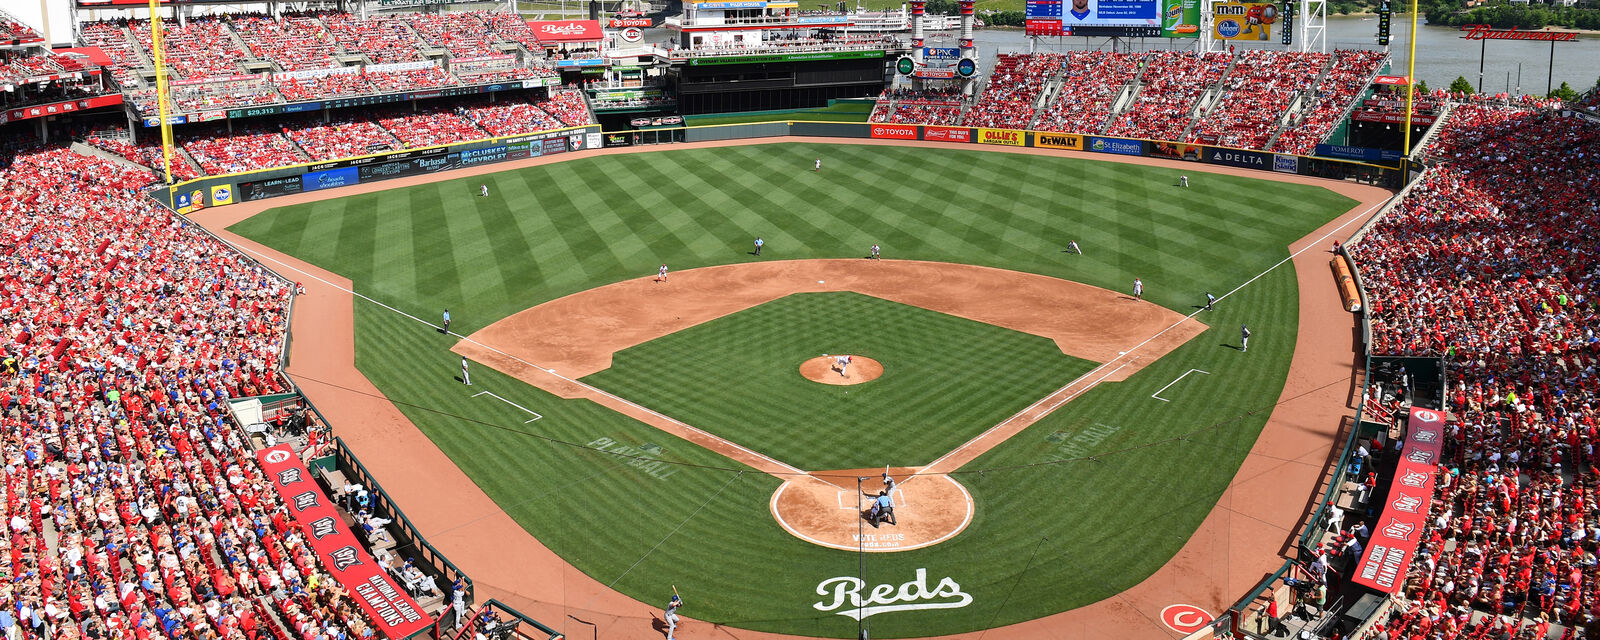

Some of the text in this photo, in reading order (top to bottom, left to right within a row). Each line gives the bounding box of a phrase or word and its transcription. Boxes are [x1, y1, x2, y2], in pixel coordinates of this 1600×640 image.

[542, 23, 586, 34] Reds
[1220, 22, 1238, 35] Kroger
[1462, 24, 1578, 41] Budweiser
[248, 108, 274, 116] $29,313
[1112, 142, 1140, 150] Elizabeth
[1331, 146, 1365, 154] POMEROY
[420, 156, 447, 168] Barbasol
[462, 153, 507, 165] CHEVROLET
[1225, 154, 1263, 165] DELTA
[1276, 155, 1297, 164] Kings
[1275, 163, 1297, 172] Island
[1388, 522, 1410, 539] 1919
[334, 548, 356, 566] 1972
[1376, 547, 1406, 587] CHAMPIONS
[369, 574, 422, 622] NATIONAL LEAGUE
[813, 568, 973, 621] Reds
[356, 583, 404, 626] CHAMPIONS
